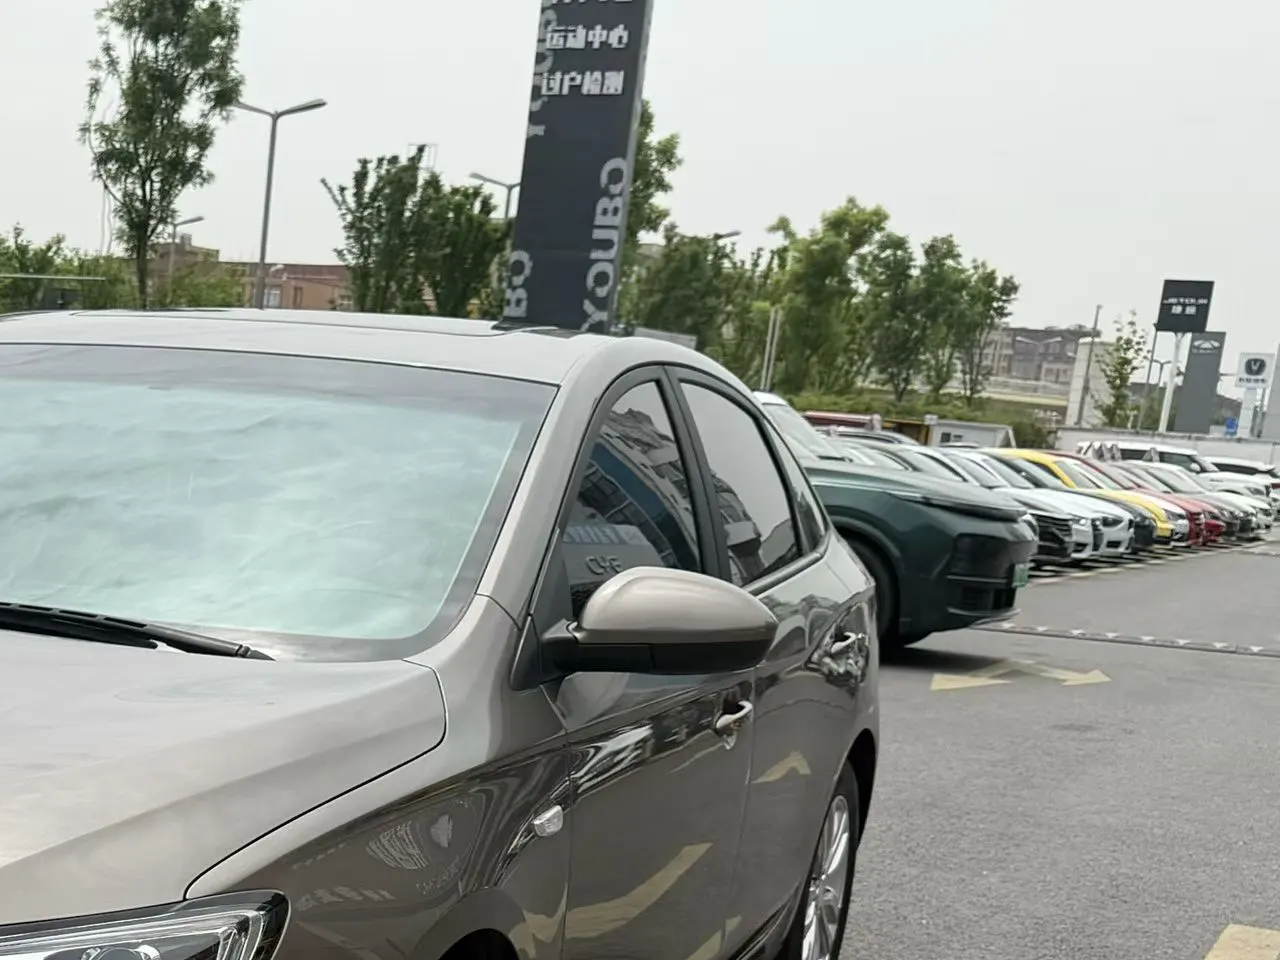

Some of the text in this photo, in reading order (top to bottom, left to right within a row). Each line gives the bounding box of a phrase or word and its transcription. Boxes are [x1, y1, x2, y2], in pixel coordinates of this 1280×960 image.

[546, 23, 629, 49] 运动中心
[541, 70, 625, 95] 过户检测
[581, 156, 628, 331] YOUBO
